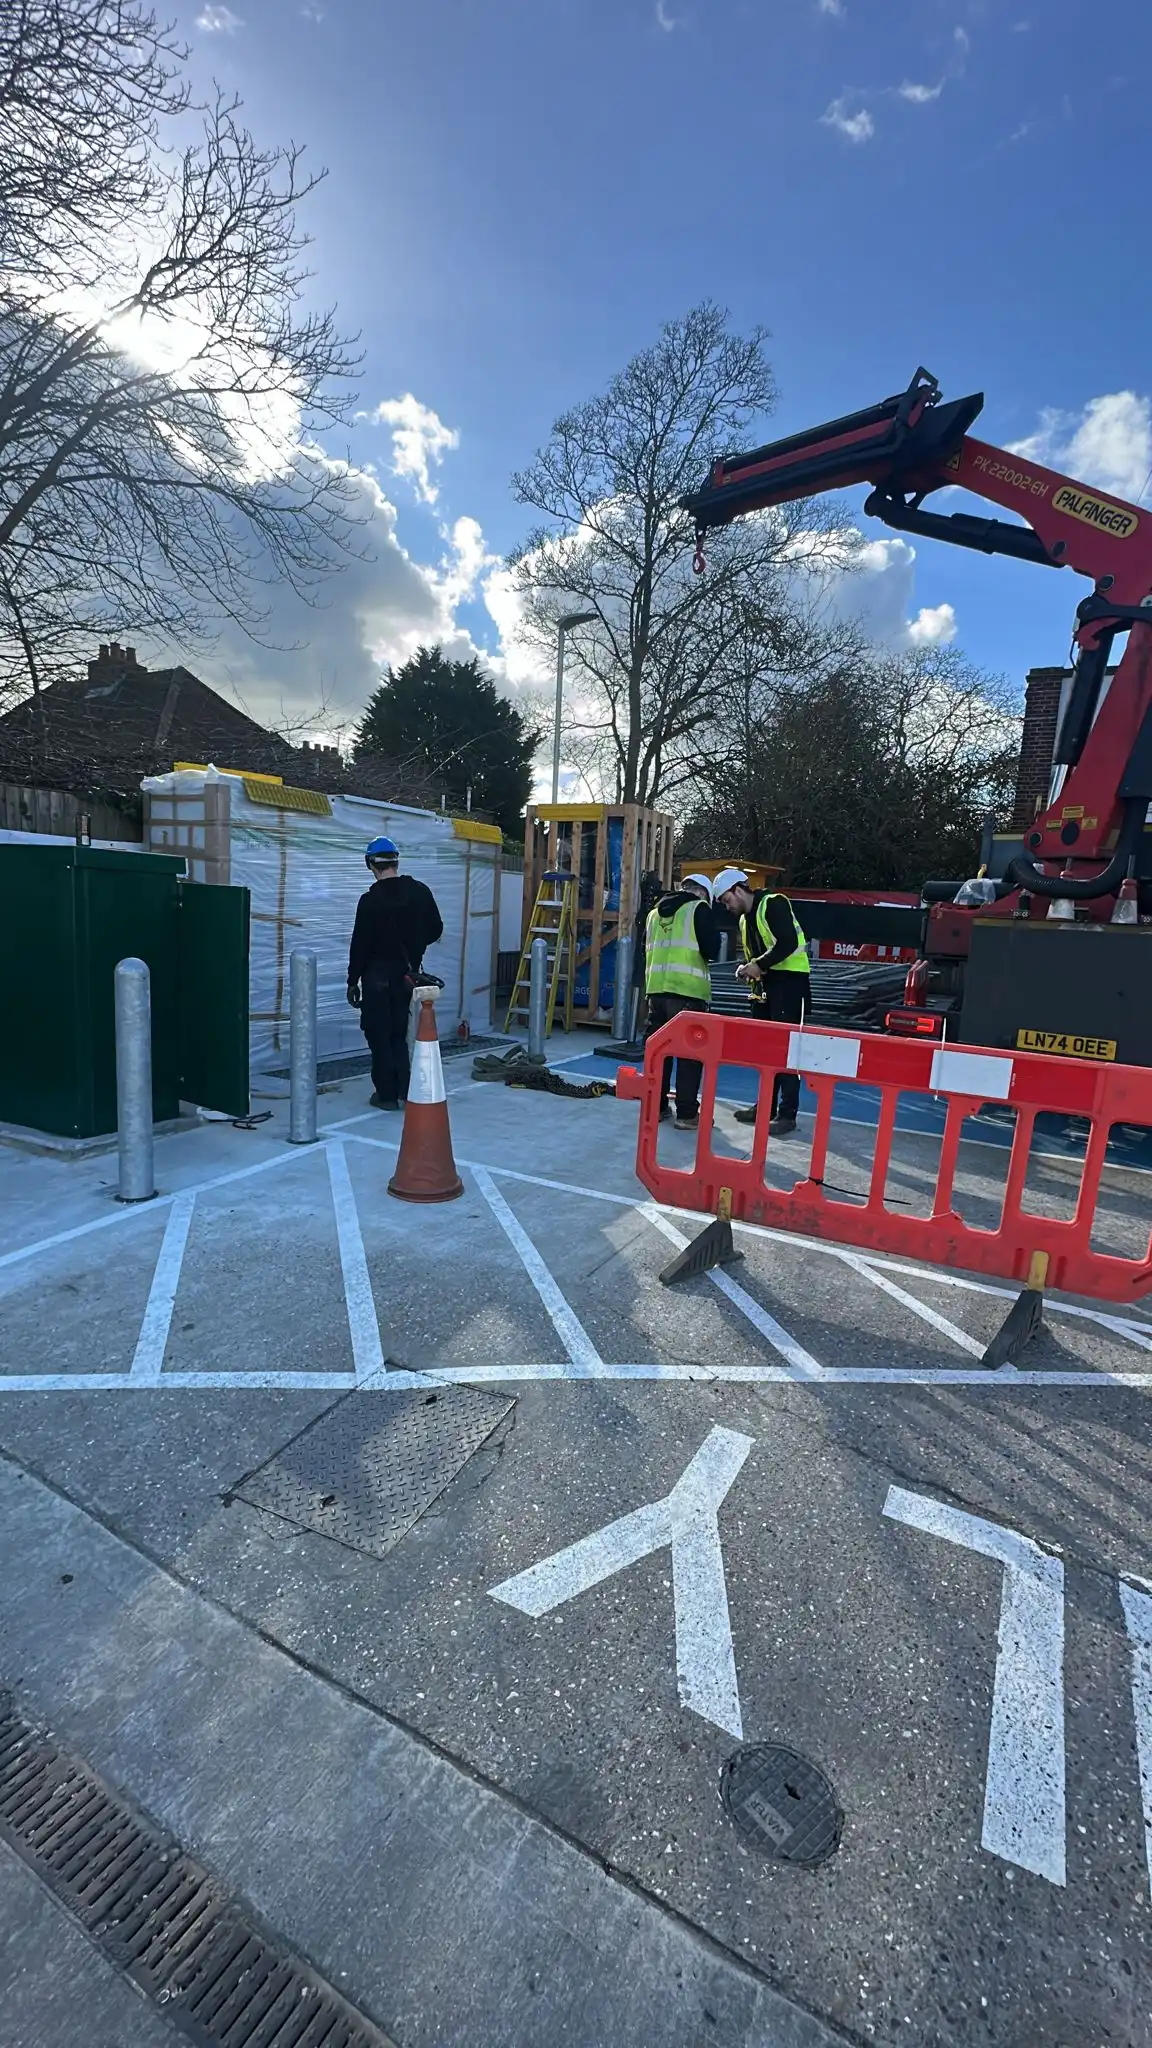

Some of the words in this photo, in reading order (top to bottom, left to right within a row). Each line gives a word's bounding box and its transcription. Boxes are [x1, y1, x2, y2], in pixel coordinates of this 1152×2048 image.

[973, 456, 988, 472] PK
[1056, 491, 1133, 535] PALFINGER
[1023, 1031, 1068, 1051] LN74
[1073, 1038, 1109, 1056] OEE
[749, 1800, 786, 1838] WATER
